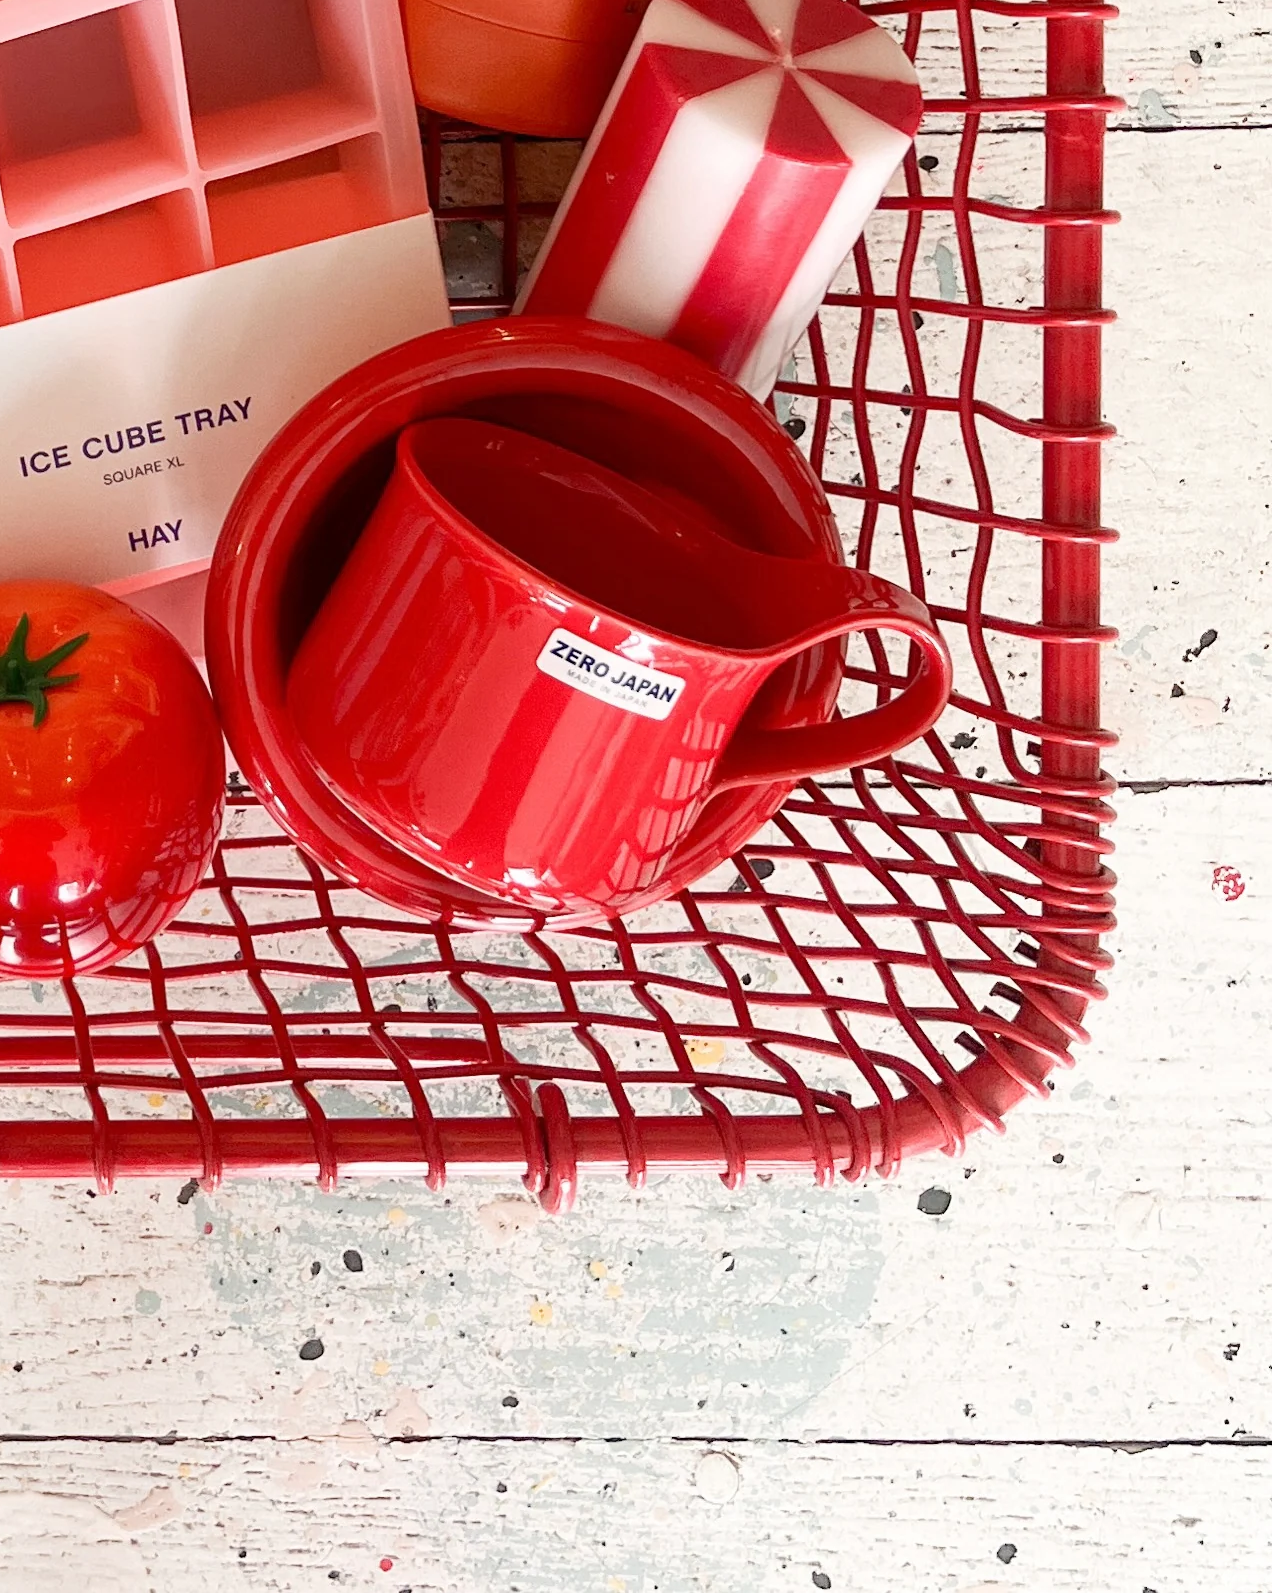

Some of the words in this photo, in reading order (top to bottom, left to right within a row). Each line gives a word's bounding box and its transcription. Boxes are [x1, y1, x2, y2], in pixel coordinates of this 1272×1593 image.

[20, 445, 72, 477] ICE
[82, 420, 166, 459] CUBE
[174, 397, 251, 435] TRAY
[103, 460, 163, 486] SQUARE
[167, 456, 185, 470] XL
[128, 519, 183, 552] HAY
[550, 640, 610, 678] ZERO
[611, 671, 676, 702] JAPAN
